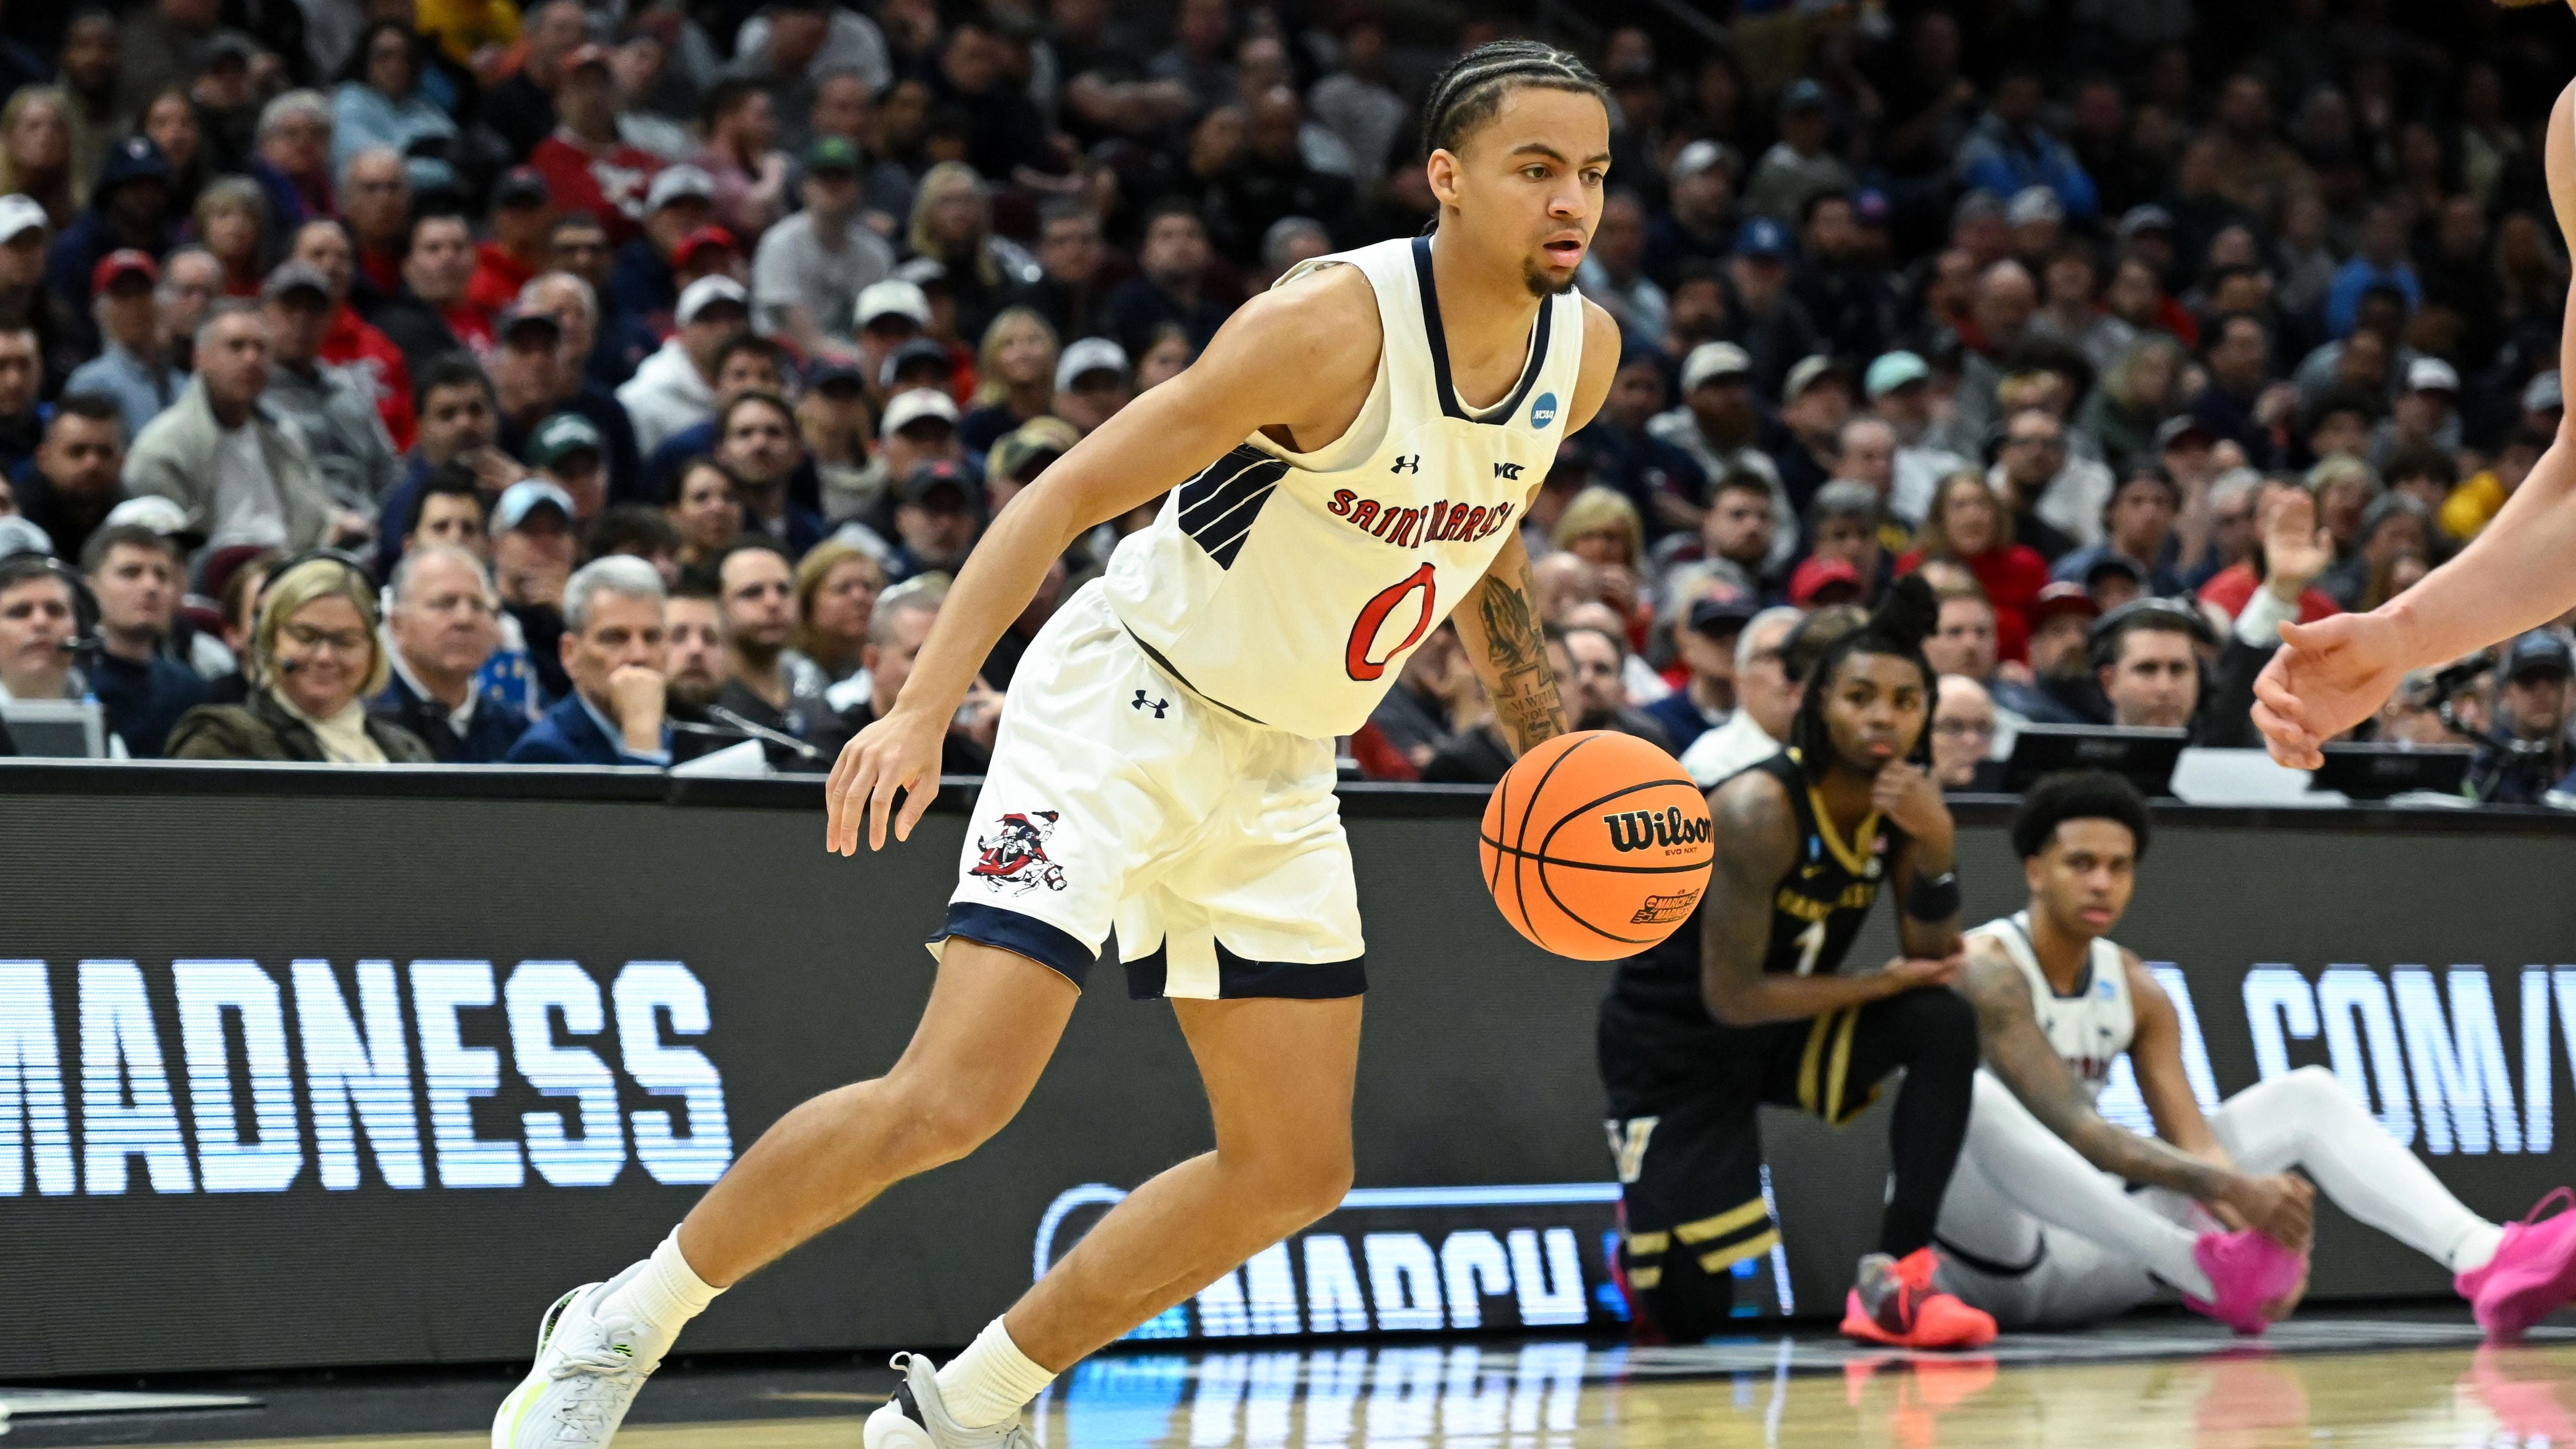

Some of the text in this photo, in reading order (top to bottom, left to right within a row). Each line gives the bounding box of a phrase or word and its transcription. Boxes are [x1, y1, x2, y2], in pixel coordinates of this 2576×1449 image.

[1533, 410, 1555, 419] NCAA
[1494, 463, 1526, 481] WCC
[1345, 561, 1436, 681] 0
[1524, 684, 1530, 695] I
[1504, 700, 1524, 714] AM
[1602, 805, 1714, 853] Wilson
